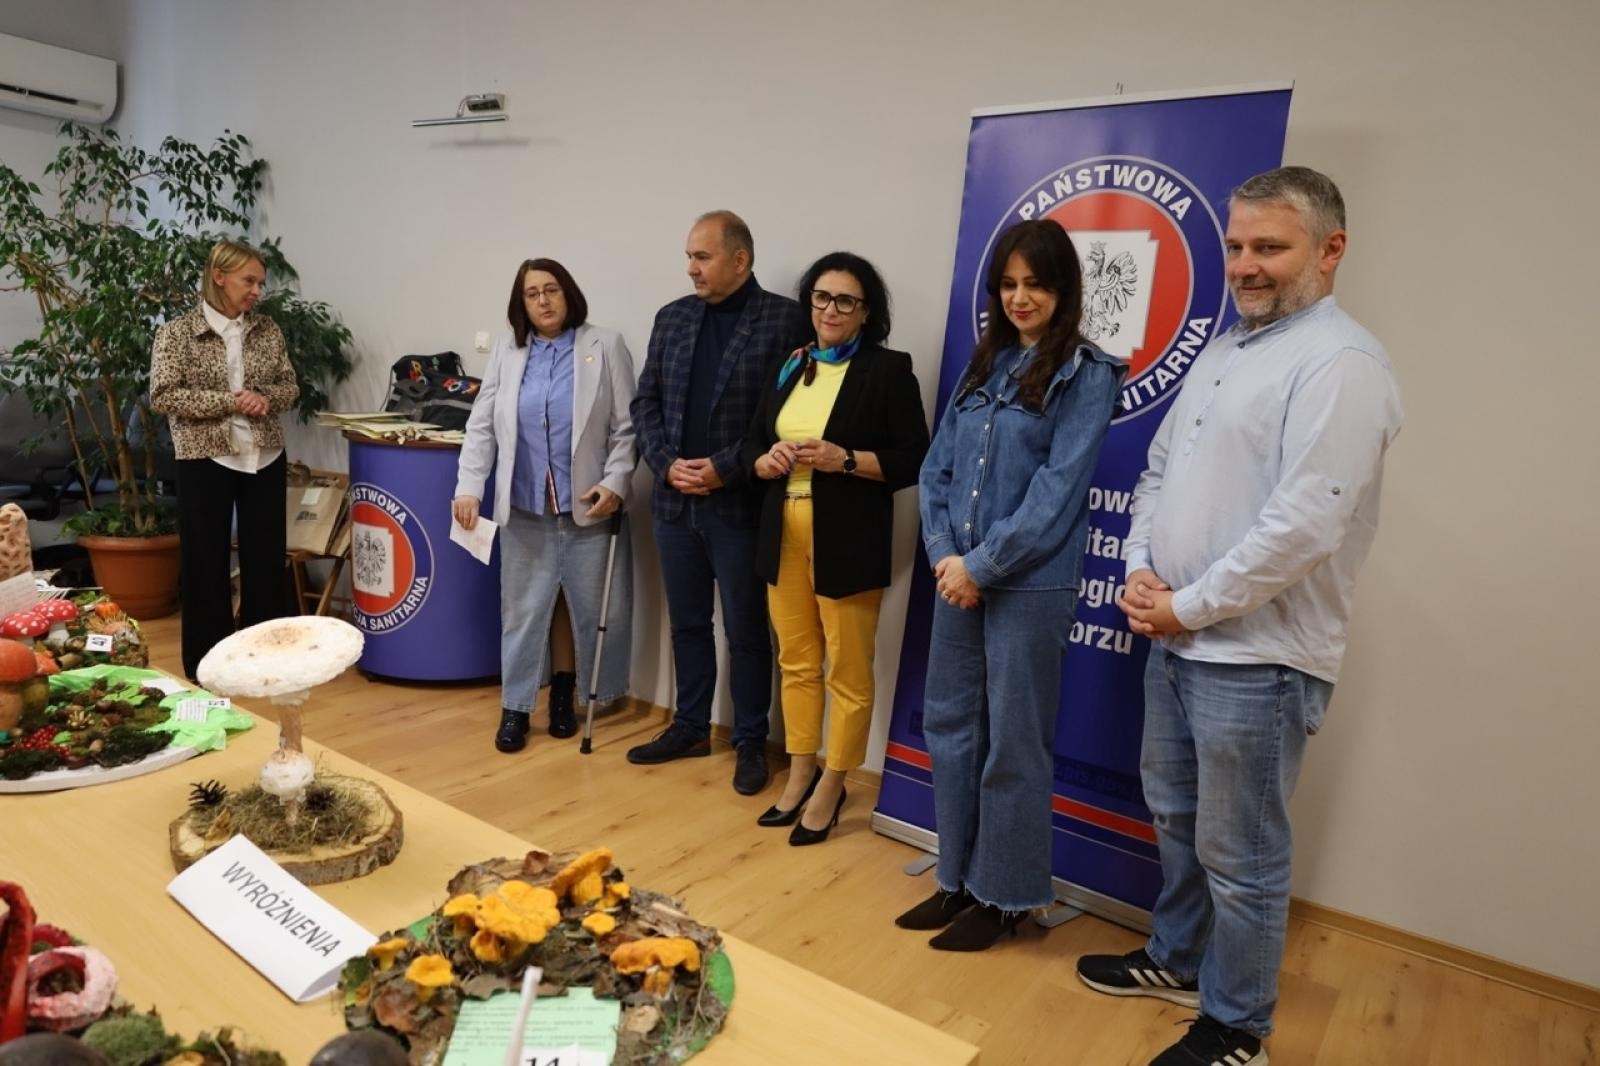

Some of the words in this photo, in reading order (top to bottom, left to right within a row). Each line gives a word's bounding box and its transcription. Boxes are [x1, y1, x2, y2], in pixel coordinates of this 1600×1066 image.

[1018, 164, 1193, 221] PAŃSTWOWA
[369, 576, 429, 631] SANITARNA
[222, 861, 341, 957] WYRÓŻNIENIA
